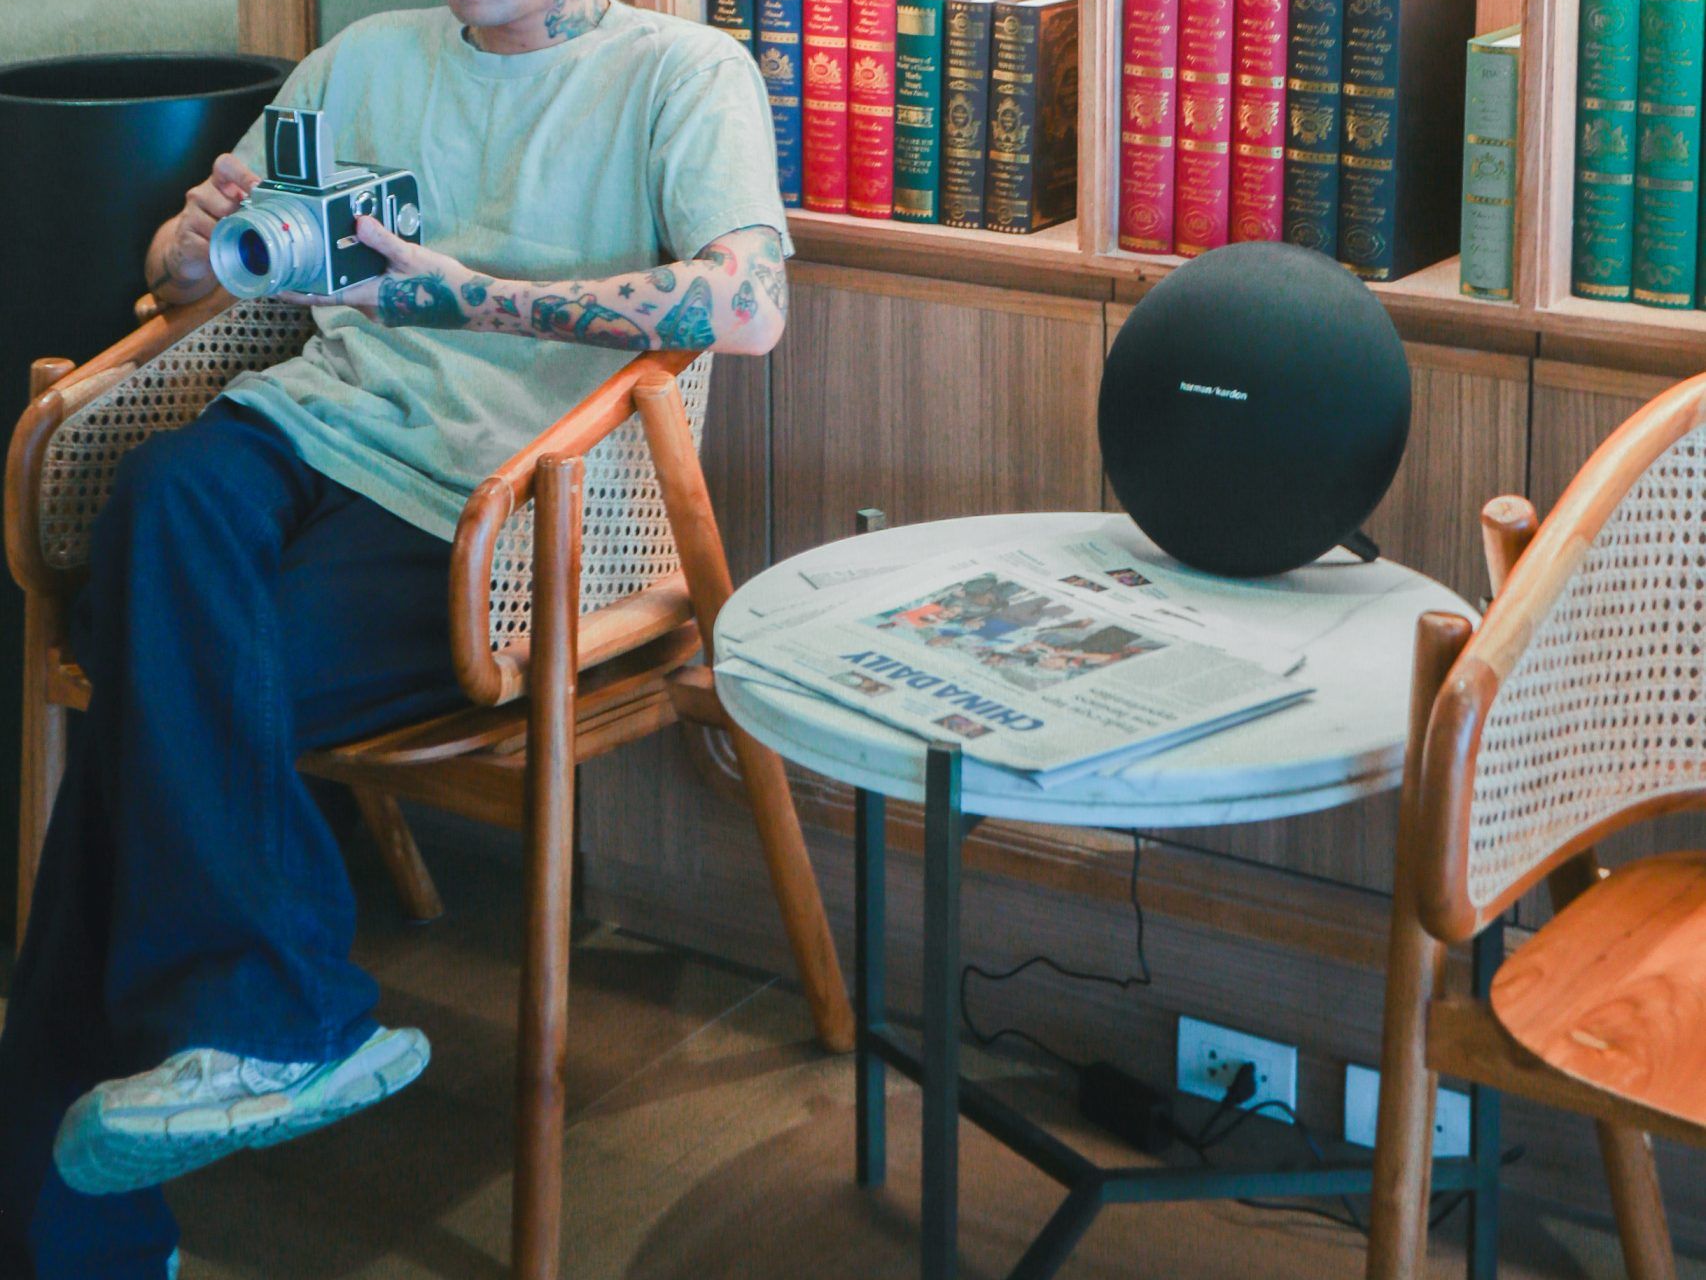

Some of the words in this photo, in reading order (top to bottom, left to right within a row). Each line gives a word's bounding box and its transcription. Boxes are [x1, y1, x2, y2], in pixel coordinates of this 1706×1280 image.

[1179, 381, 1248, 401] harman/kardon
[840, 651, 944, 691] DAILY
[932, 683, 1045, 732] CHINA
